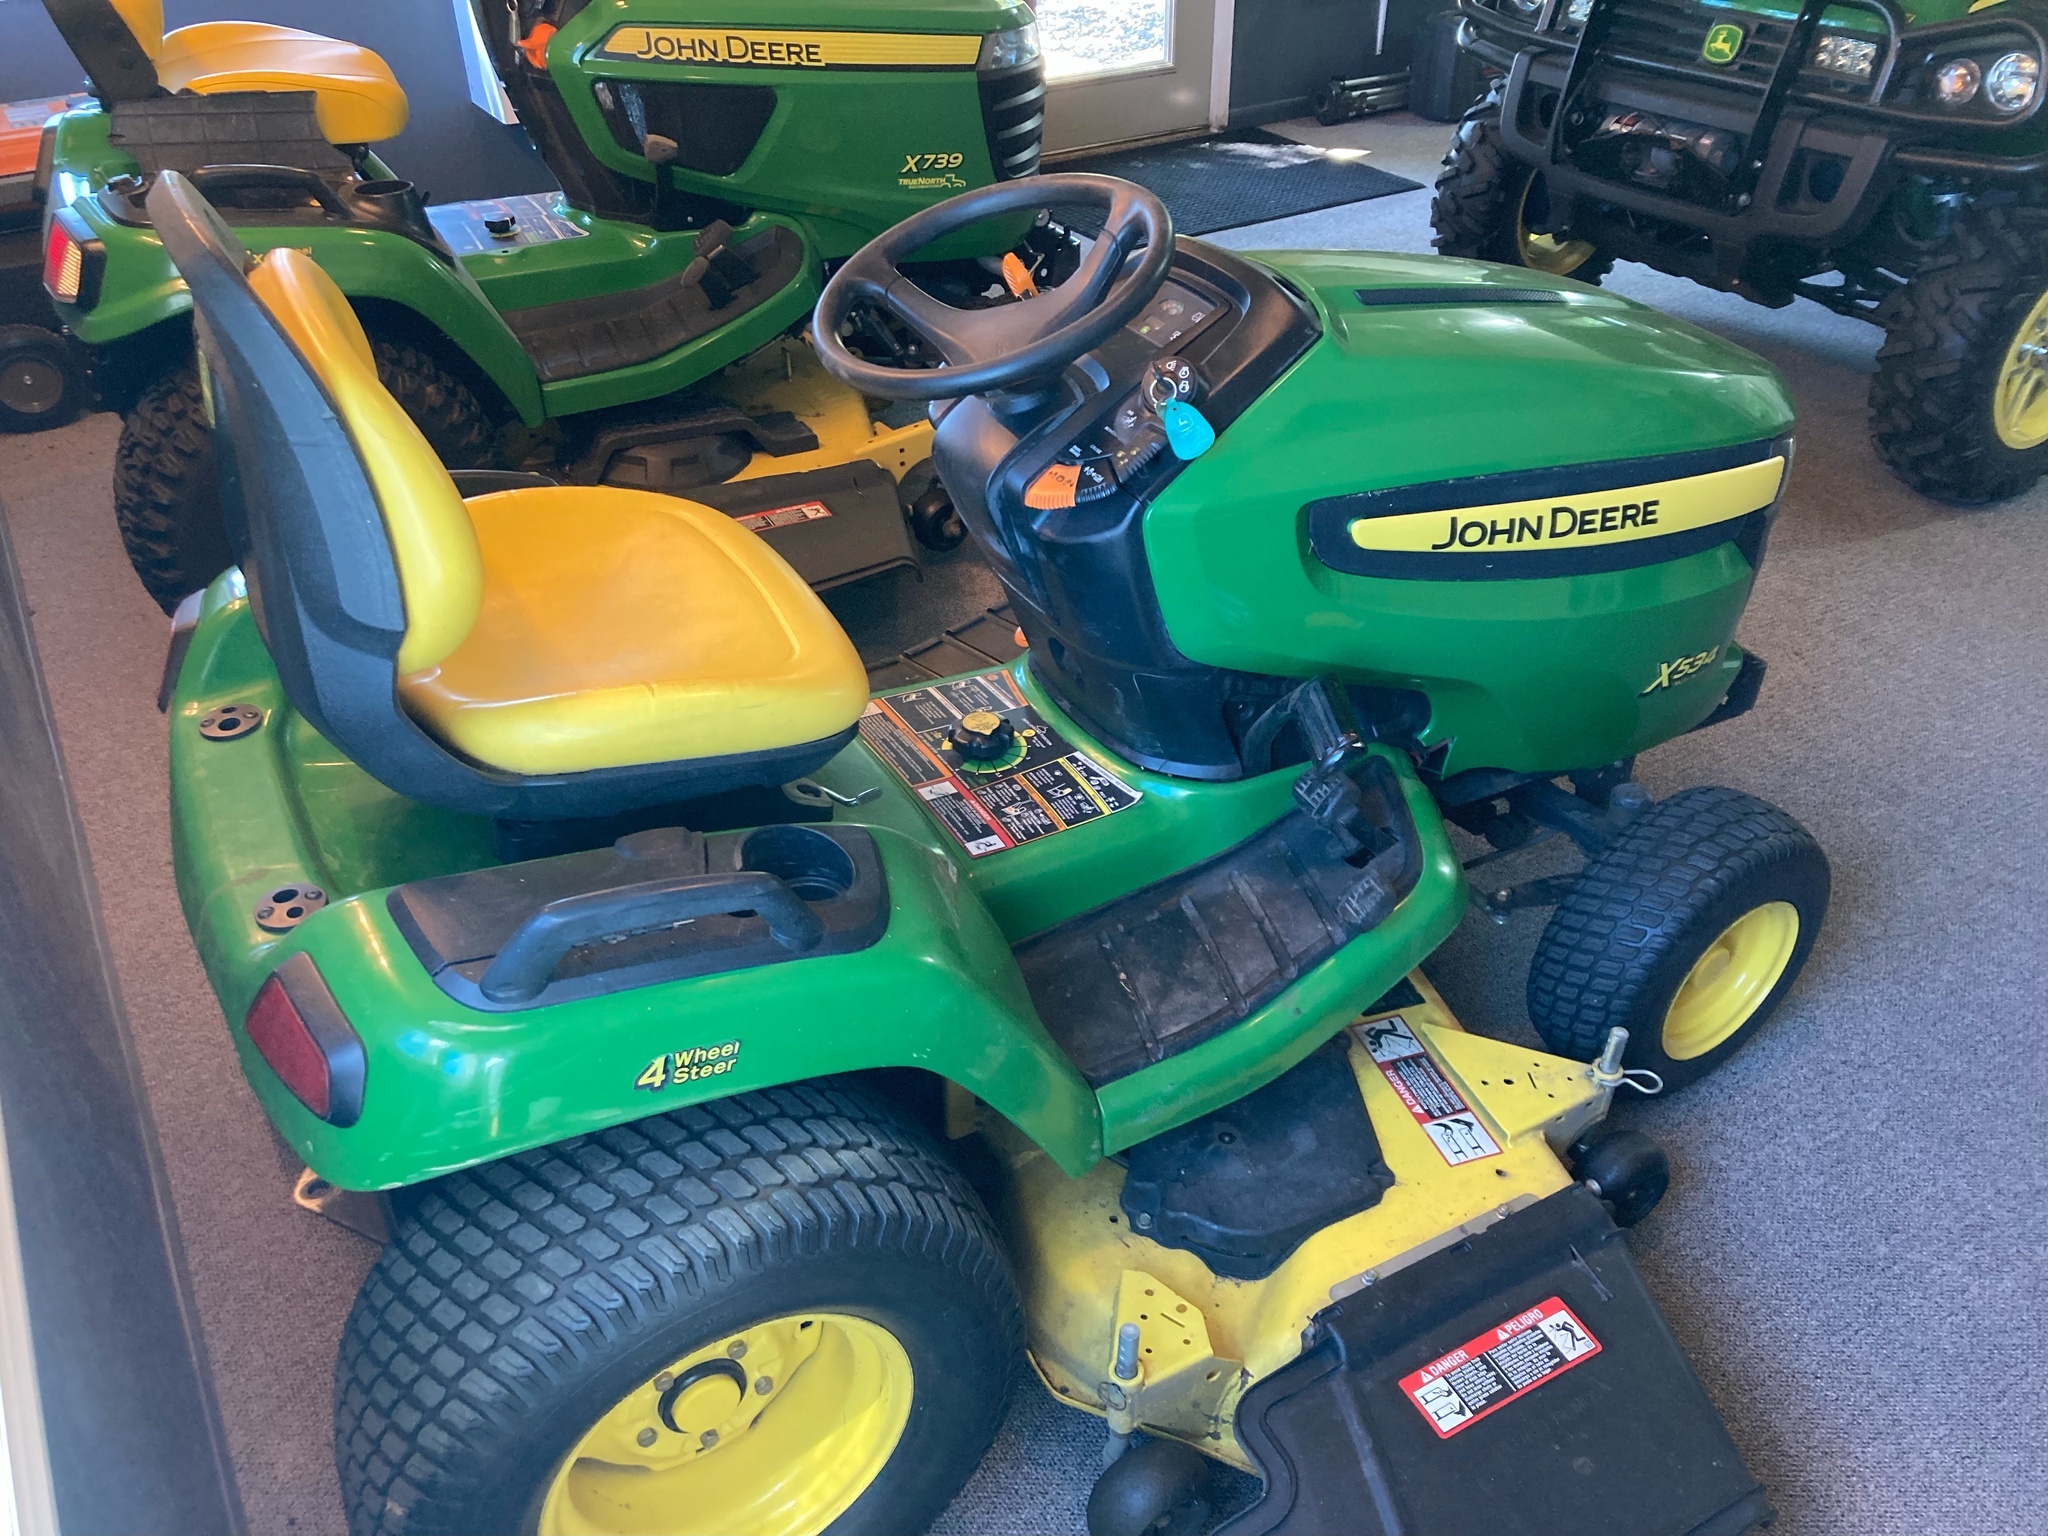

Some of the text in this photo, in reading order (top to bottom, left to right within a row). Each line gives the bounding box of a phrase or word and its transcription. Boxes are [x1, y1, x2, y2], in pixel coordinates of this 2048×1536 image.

[637, 31, 822, 63] JOHN DEERE
[900, 153, 963, 173] X739
[1431, 500, 1660, 550] JOHN DEERE
[1642, 645, 1720, 694] X534
[637, 1041, 740, 1088] 4 Wheel
[671, 1058, 738, 1084] Steer
[1385, 1070, 1415, 1105] DANGER
[1505, 1308, 1544, 1335] PELIGRO
[1430, 1350, 1469, 1376] DANGER
